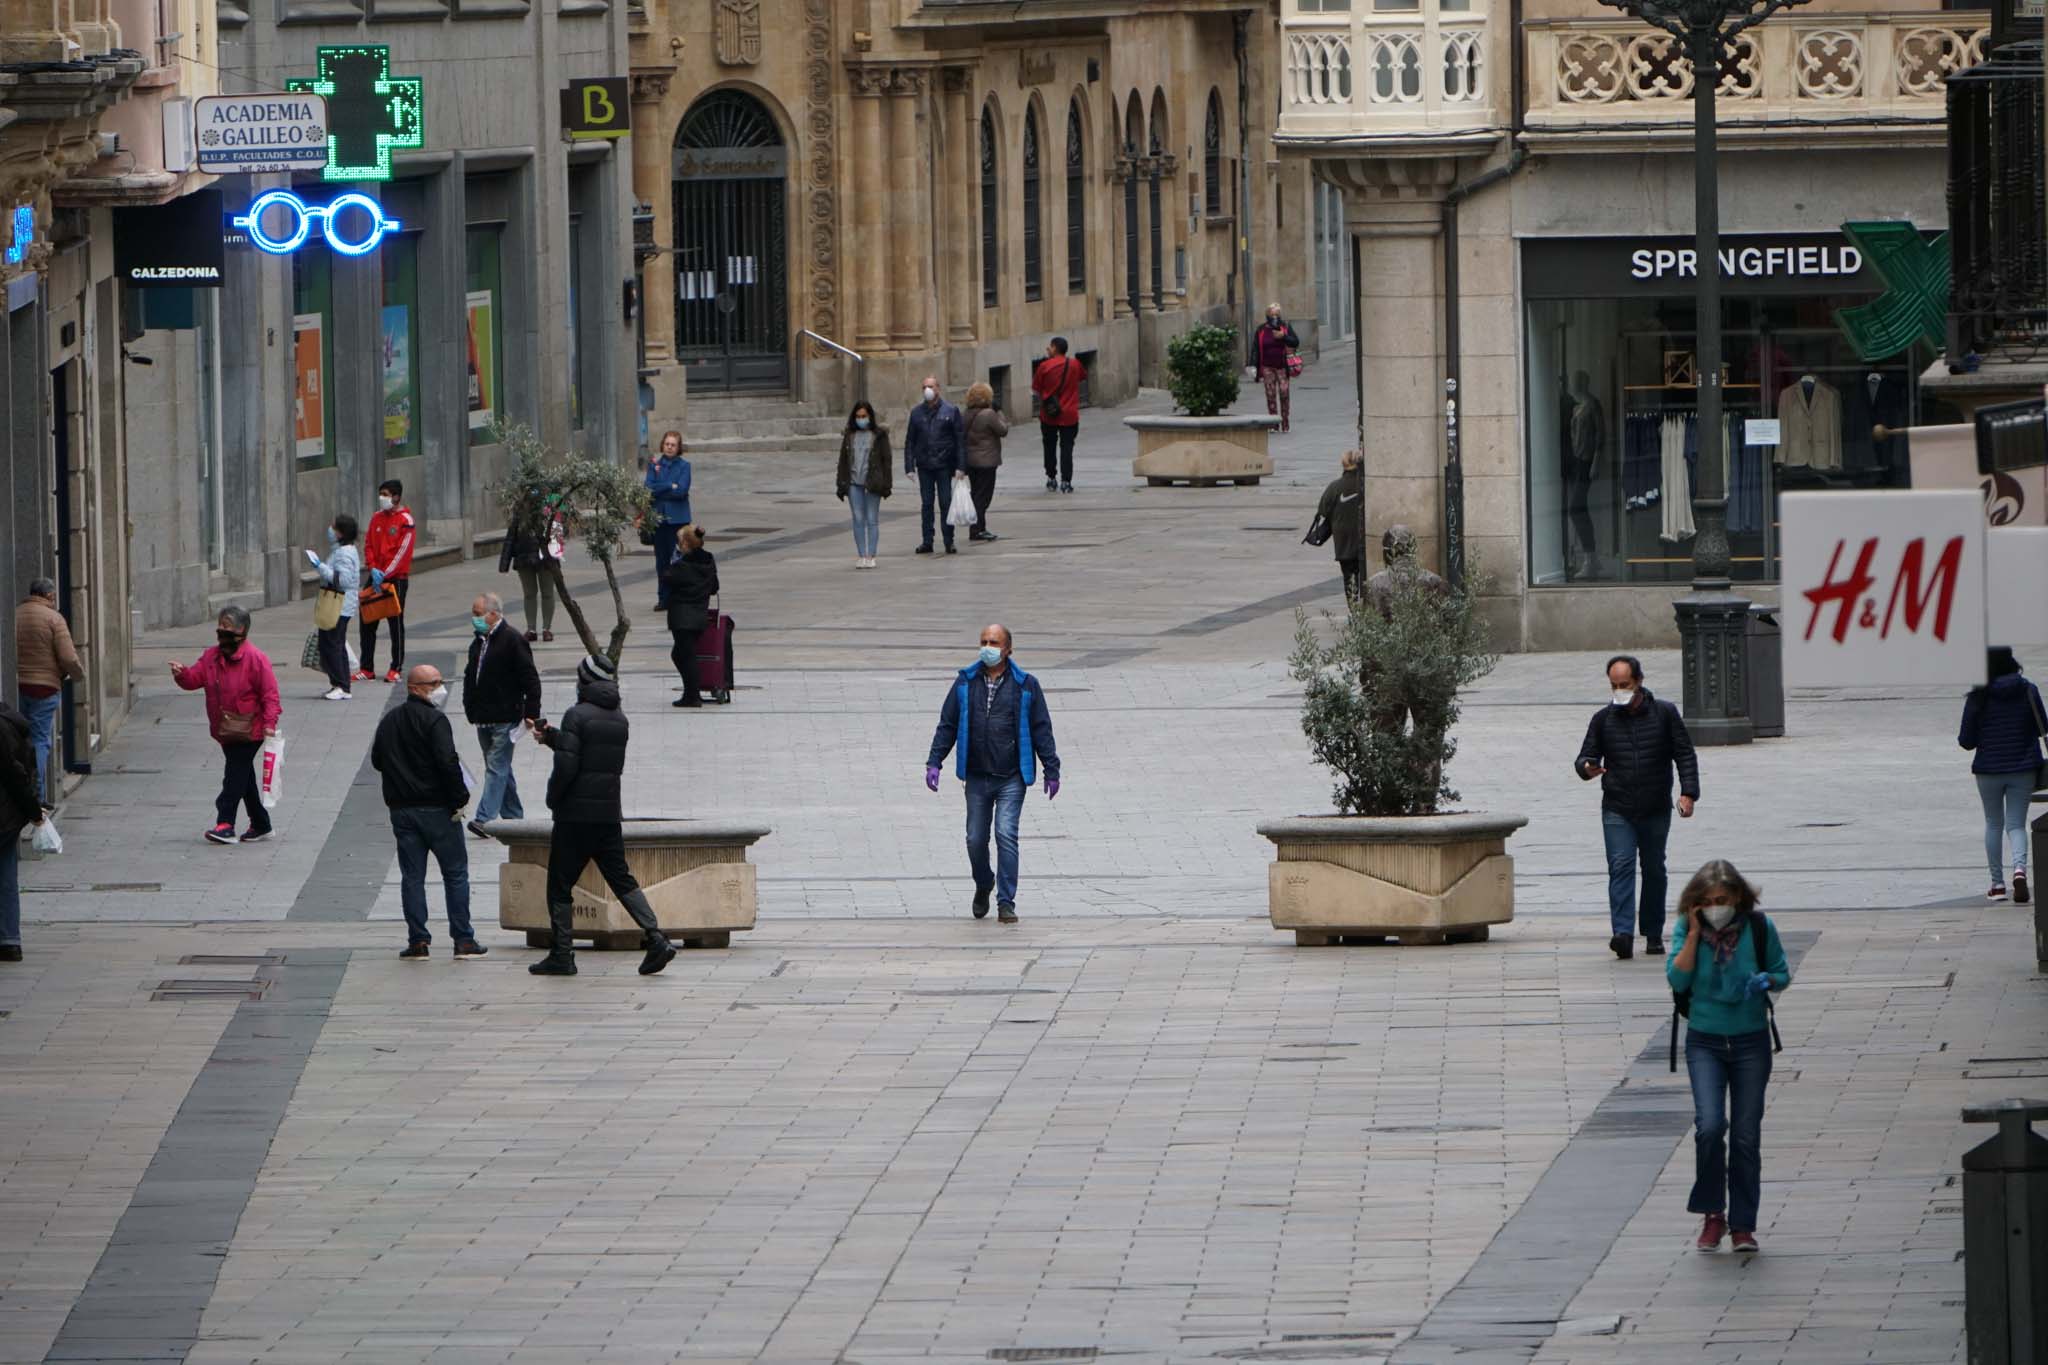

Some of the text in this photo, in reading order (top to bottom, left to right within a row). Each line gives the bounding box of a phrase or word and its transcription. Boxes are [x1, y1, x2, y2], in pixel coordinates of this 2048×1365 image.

[212, 103, 313, 123] ACADEMIA
[583, 85, 615, 124] B
[222, 125, 303, 146] GALILEO
[201, 150, 325, 161] B.U.P. FACULTADES C.O.U.
[1631, 246, 1862, 278] SPRNGFIELD
[131, 267, 219, 279] CALZEDONIA
[1802, 535, 1965, 644] H&M
